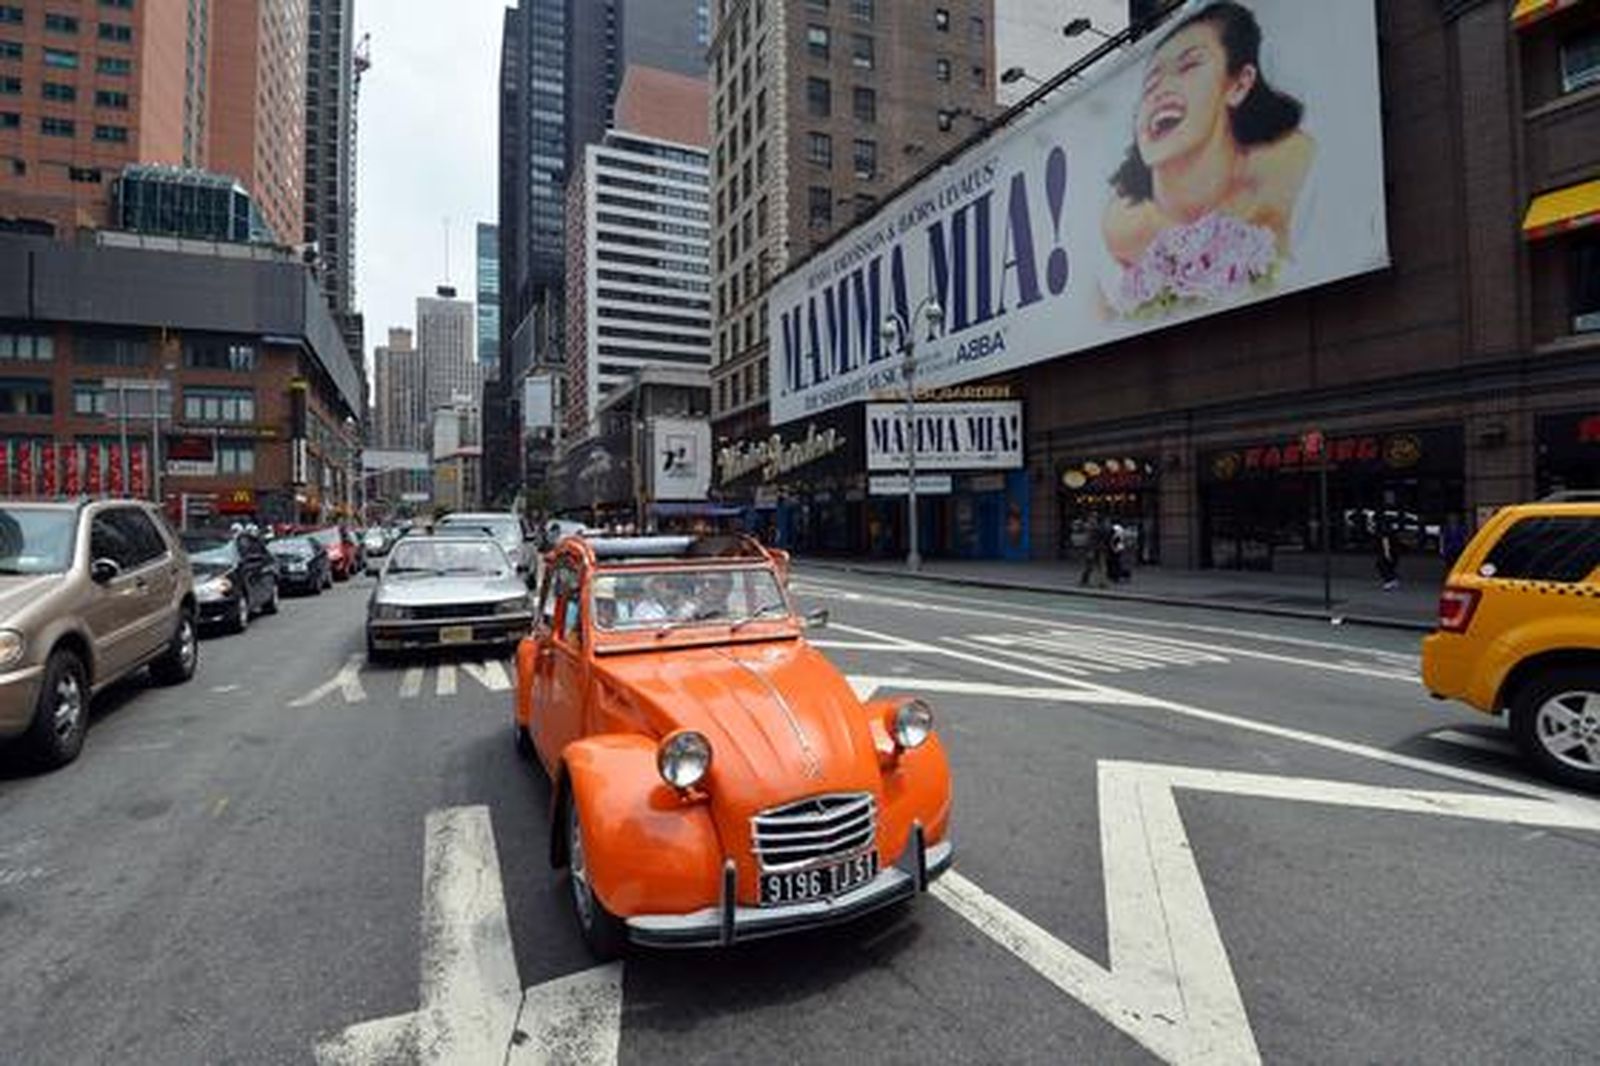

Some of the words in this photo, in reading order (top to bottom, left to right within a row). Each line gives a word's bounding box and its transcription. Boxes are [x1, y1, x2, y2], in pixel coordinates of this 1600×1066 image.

[780, 242, 911, 397] MAMMA
[926, 146, 1070, 343] MIA!
[955, 332, 1005, 364] ABBA
[966, 415, 1018, 453] MIA!
[767, 870, 821, 902] 9196
